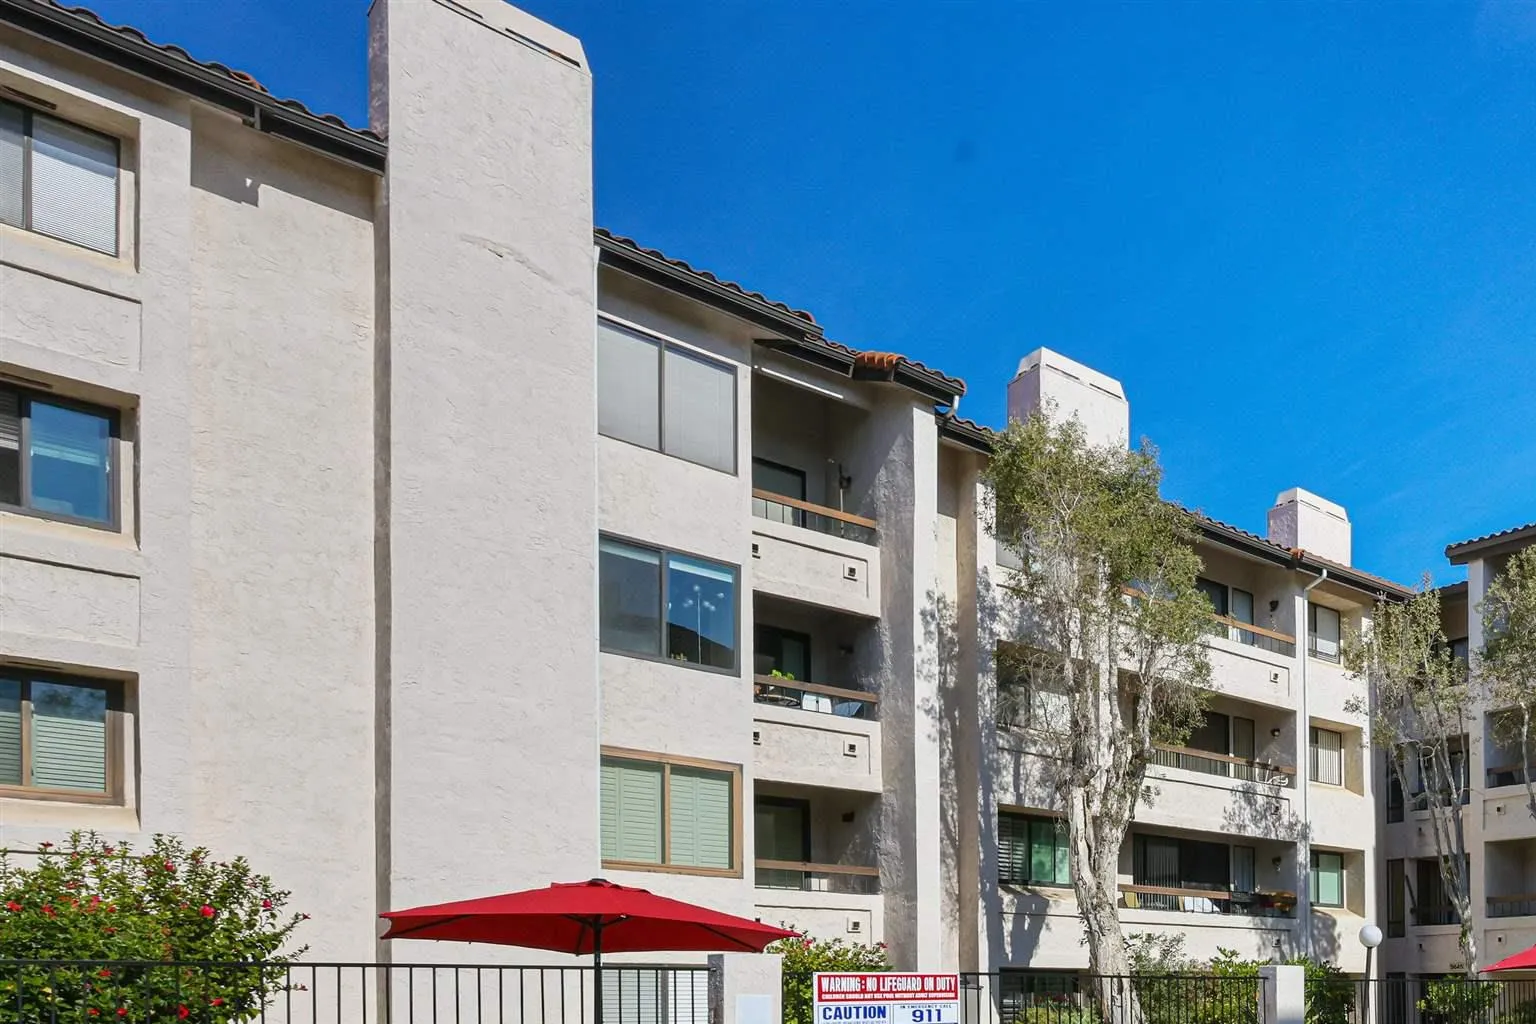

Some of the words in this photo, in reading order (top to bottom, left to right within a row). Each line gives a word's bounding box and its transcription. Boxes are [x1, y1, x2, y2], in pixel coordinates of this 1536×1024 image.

[821, 976, 865, 992] WARNING:
[866, 976, 877, 992] NO
[879, 976, 922, 992] LIFEGUARD
[923, 976, 934, 992] ON
[936, 976, 956, 992] DUTY
[823, 1006, 887, 1020] CAUTION
[912, 1009, 941, 1022] 911
